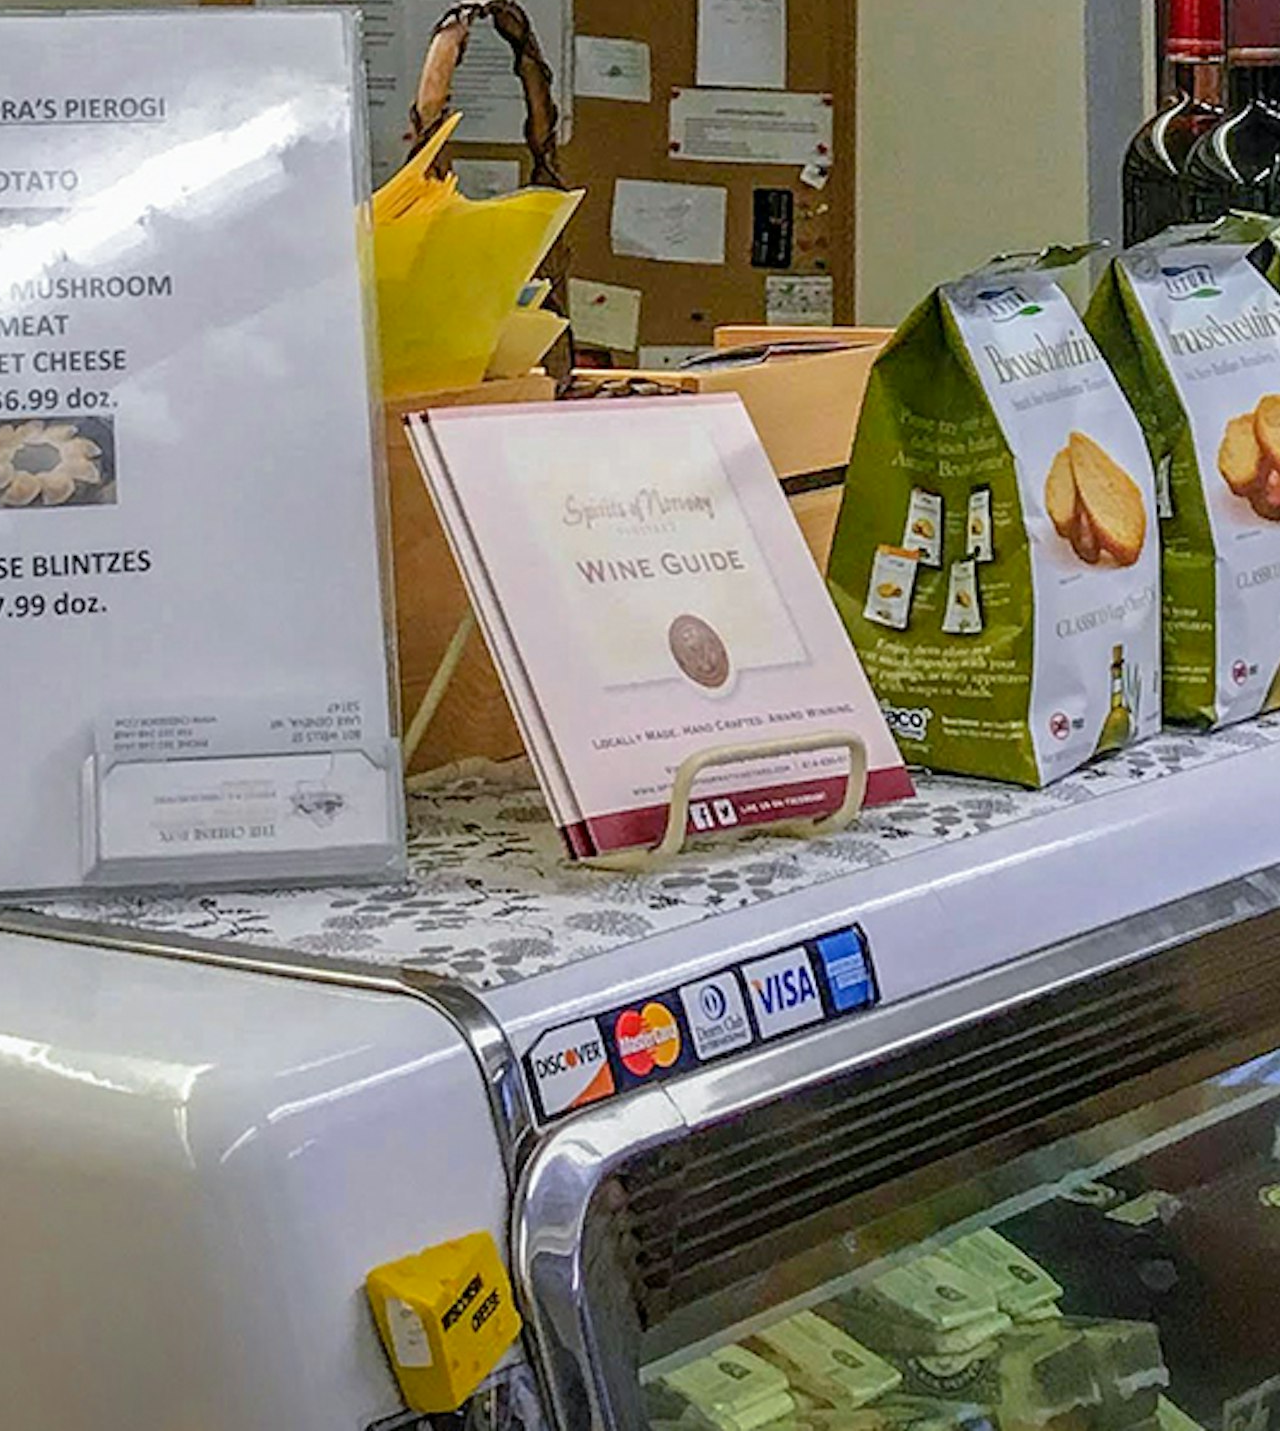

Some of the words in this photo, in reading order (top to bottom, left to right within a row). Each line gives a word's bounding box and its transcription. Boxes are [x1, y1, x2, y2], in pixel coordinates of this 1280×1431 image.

[65, 96, 167, 119] PIEROGI
[10, 274, 173, 301] MUSHROOM
[33, 349, 128, 373] CHEESE
[66, 386, 119, 410] doz.
[32, 549, 152, 577] BLINTZES
[53, 591, 108, 616] doz.
[753, 965, 816, 1015] VISA
[535, 1039, 604, 1080] DISCOVER
